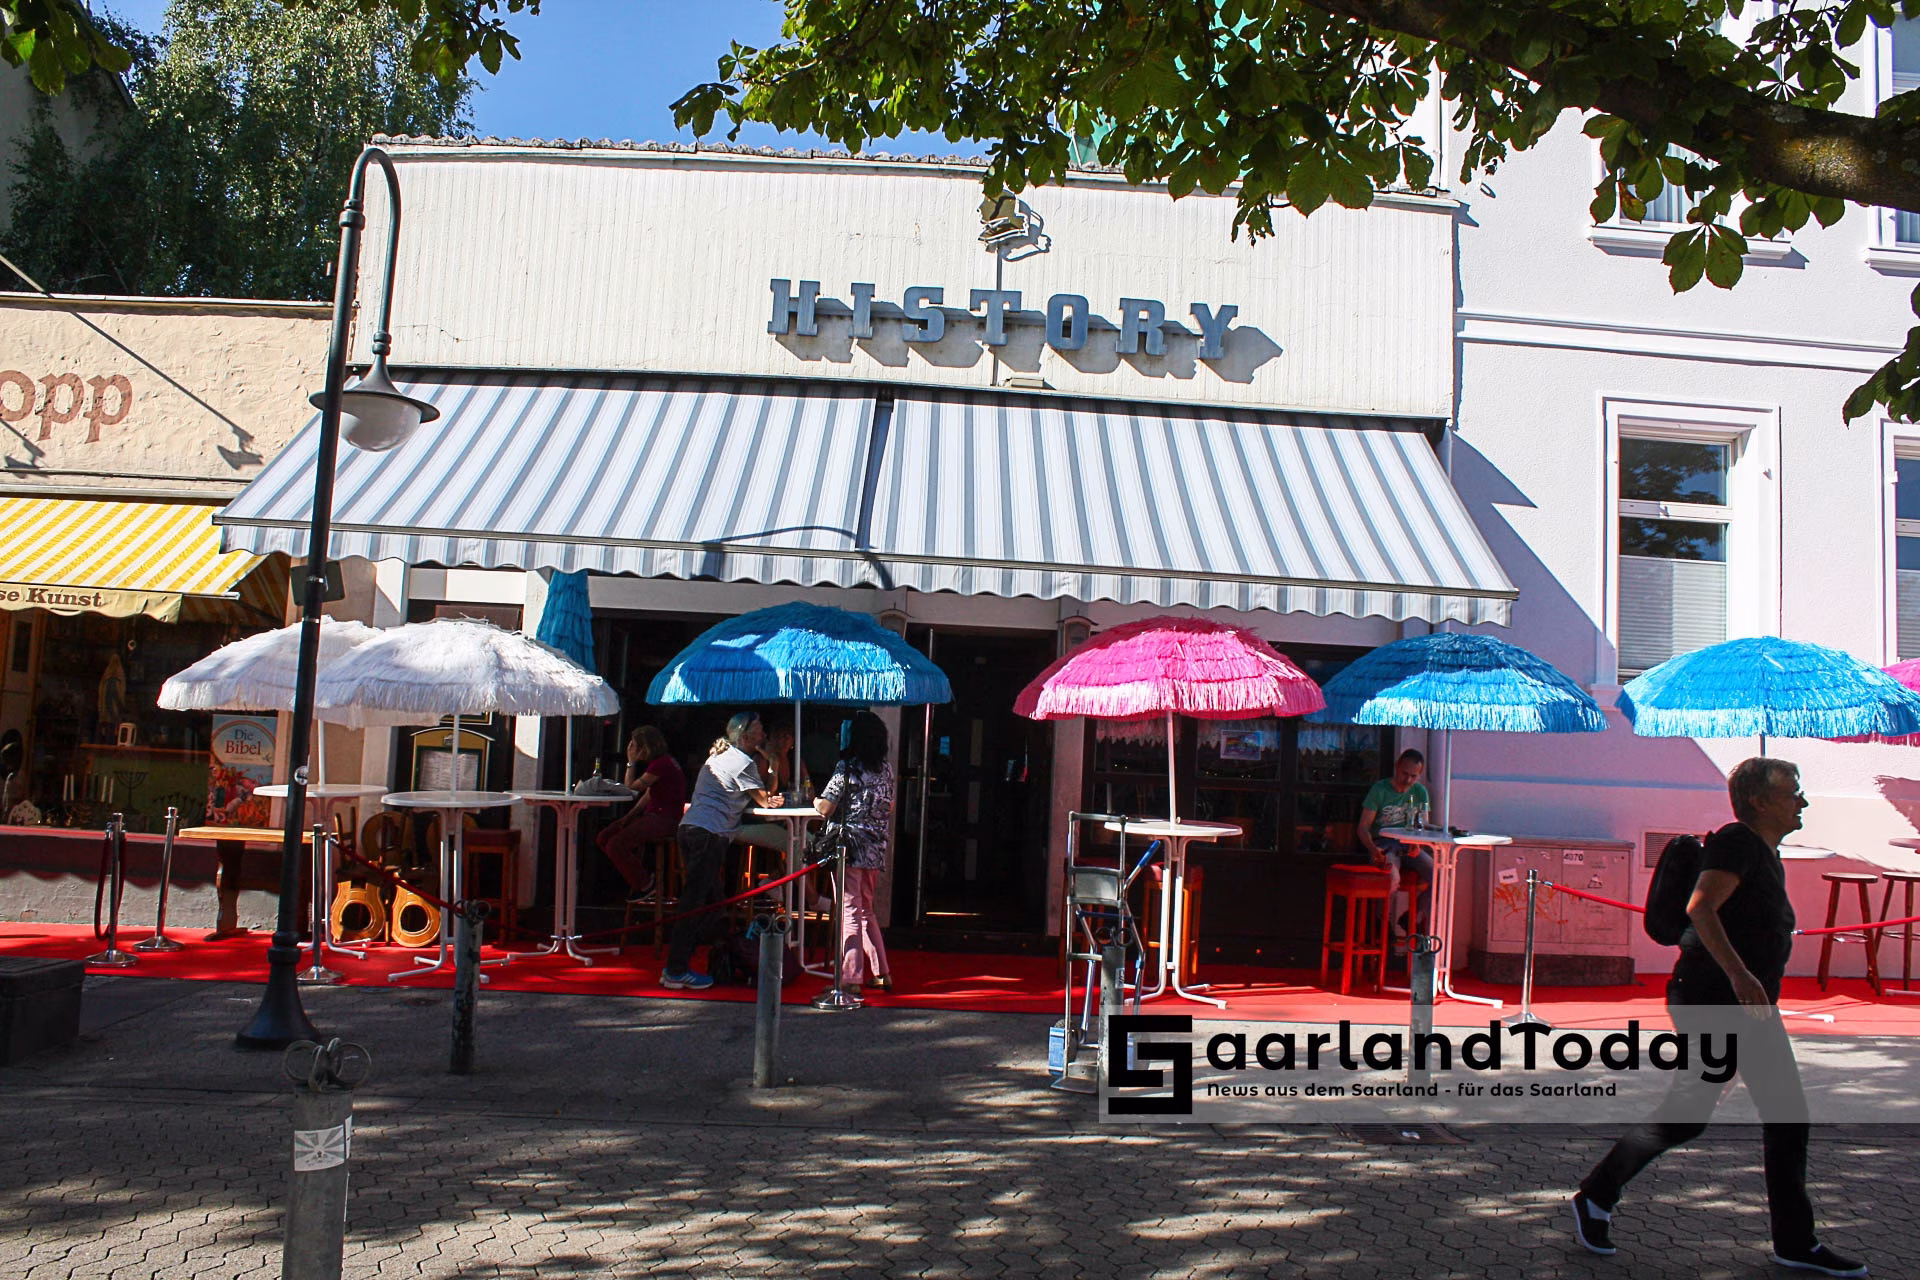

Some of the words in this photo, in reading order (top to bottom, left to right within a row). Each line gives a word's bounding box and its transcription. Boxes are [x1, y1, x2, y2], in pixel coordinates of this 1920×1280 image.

[768, 279, 1239, 360] HISTORY
[0, 370, 132, 444] opp
[26, 588, 103, 607] Kunst
[234, 729, 254, 741] Die
[225, 740, 261, 755] Bibel
